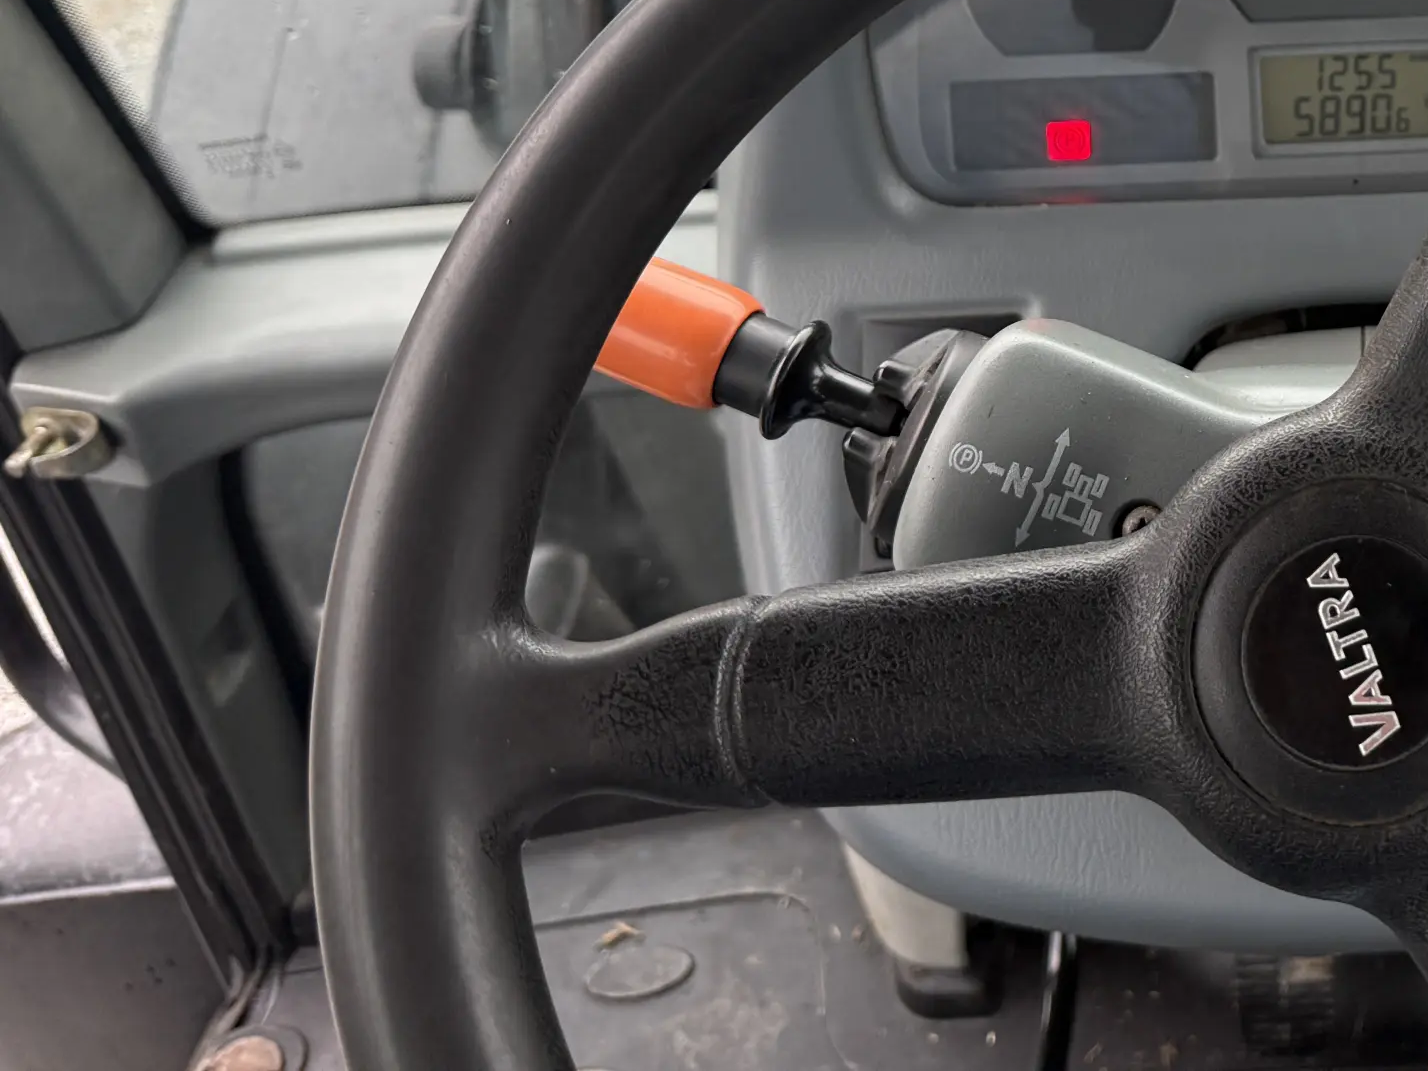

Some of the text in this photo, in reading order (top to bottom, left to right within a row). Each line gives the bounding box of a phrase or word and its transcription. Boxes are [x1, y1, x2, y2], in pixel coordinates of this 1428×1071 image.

[1317, 54, 1397, 92] 1255
[1001, 461, 1034, 499] N
[1306, 552, 1401, 756] VALTRA
